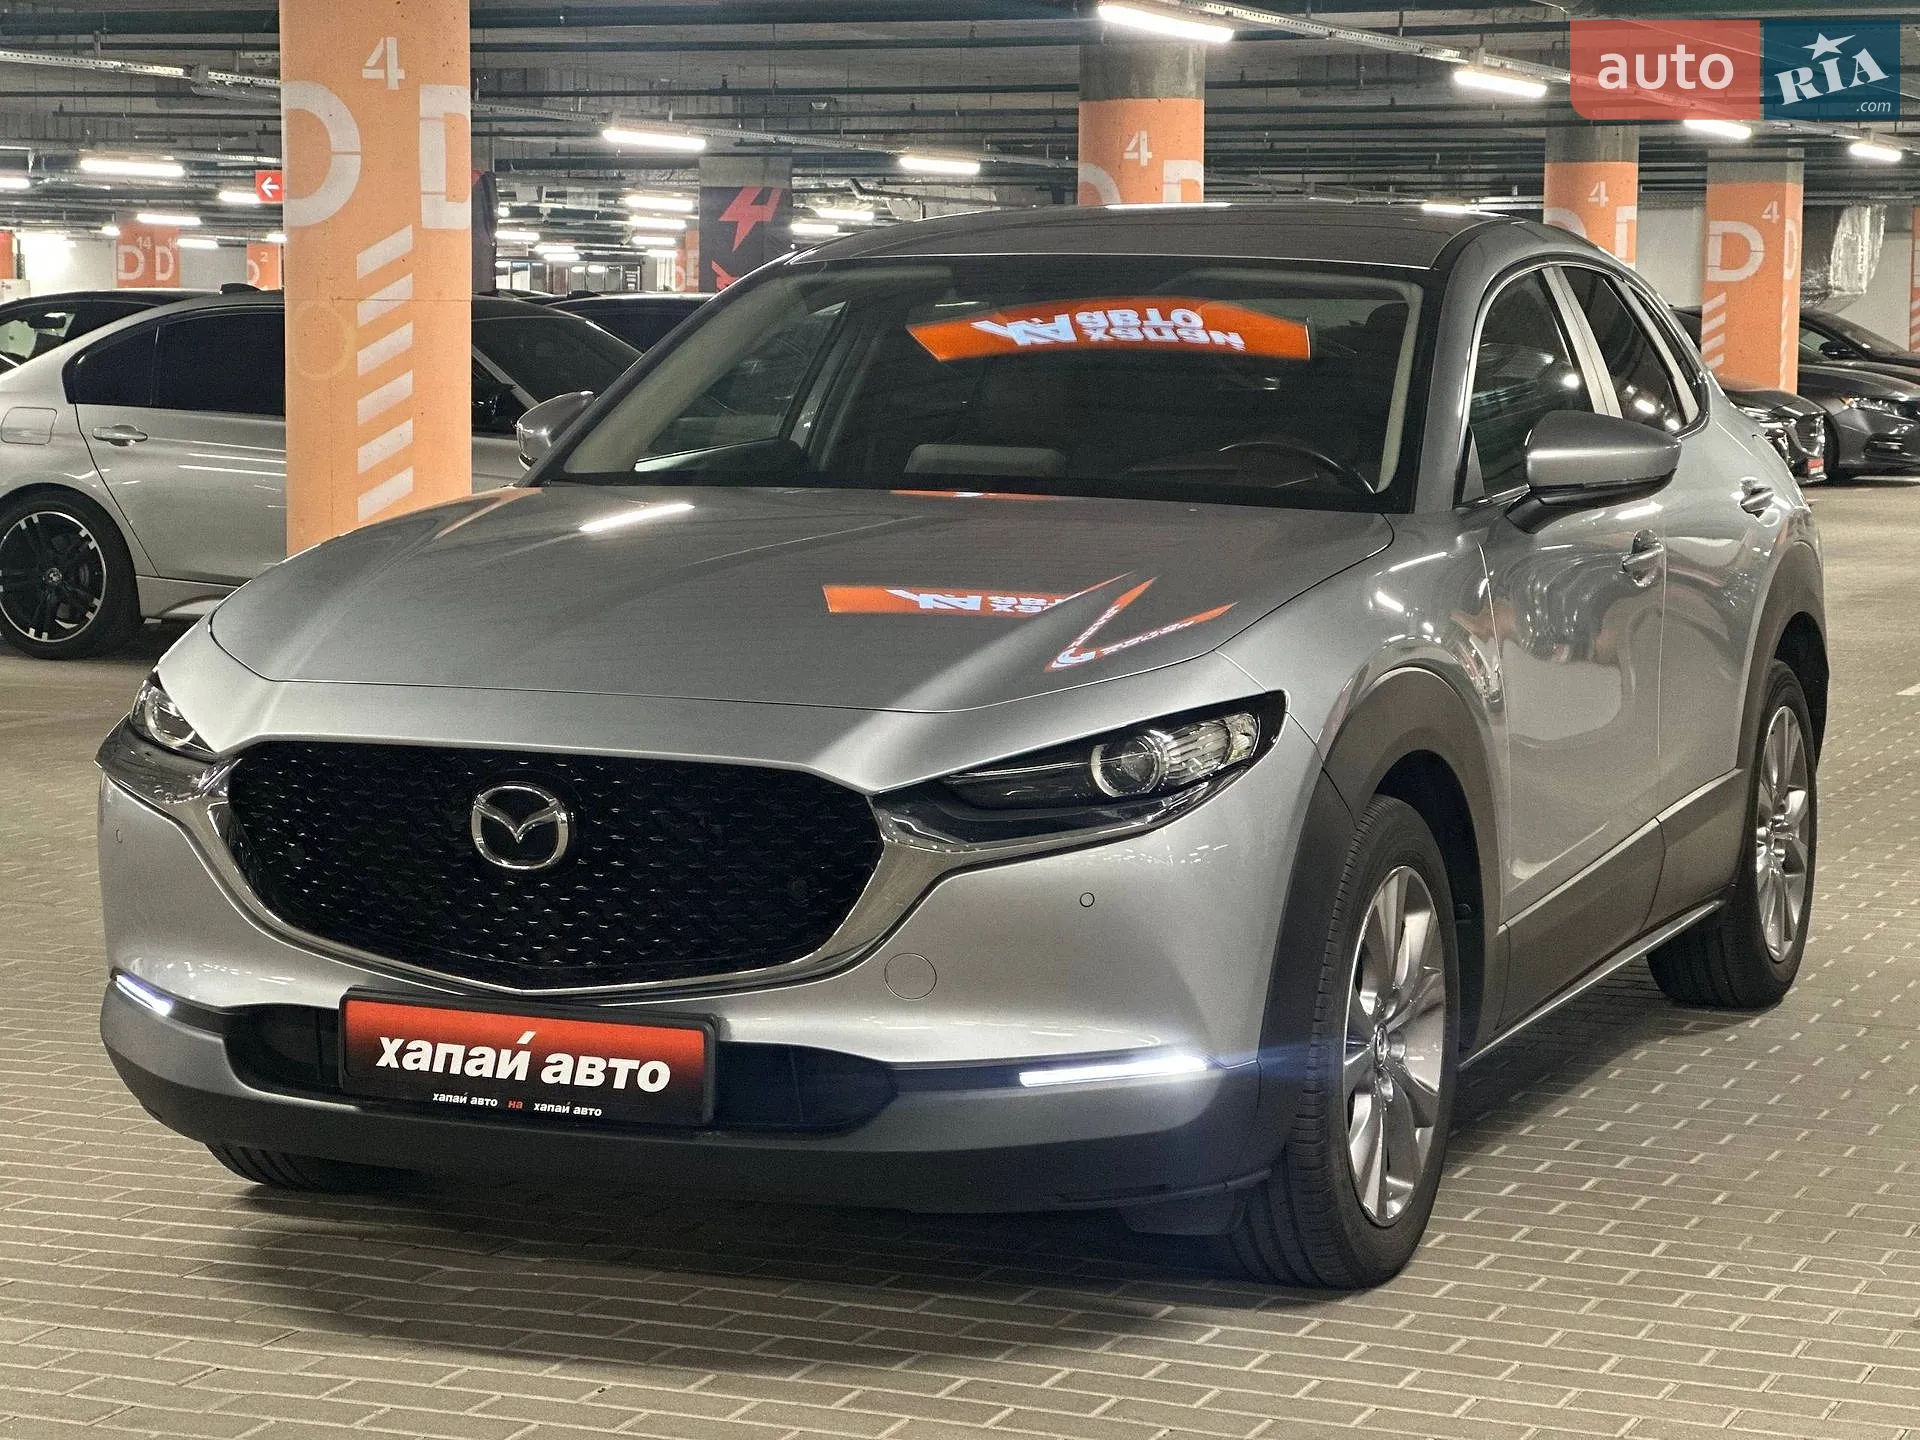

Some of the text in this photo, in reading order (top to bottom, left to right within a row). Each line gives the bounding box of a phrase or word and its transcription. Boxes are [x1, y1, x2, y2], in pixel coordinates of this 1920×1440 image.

[362, 37, 405, 90] 4
[1123, 130, 1152, 167] 4
[1588, 181, 1609, 207] 4
[1707, 201, 1780, 282] D 4
[117, 245, 145, 280] D
[540, 1053, 671, 1093] авто
[470, 1095, 498, 1107] авто
[507, 1100, 524, 1110] на
[573, 1105, 602, 1117] авто
